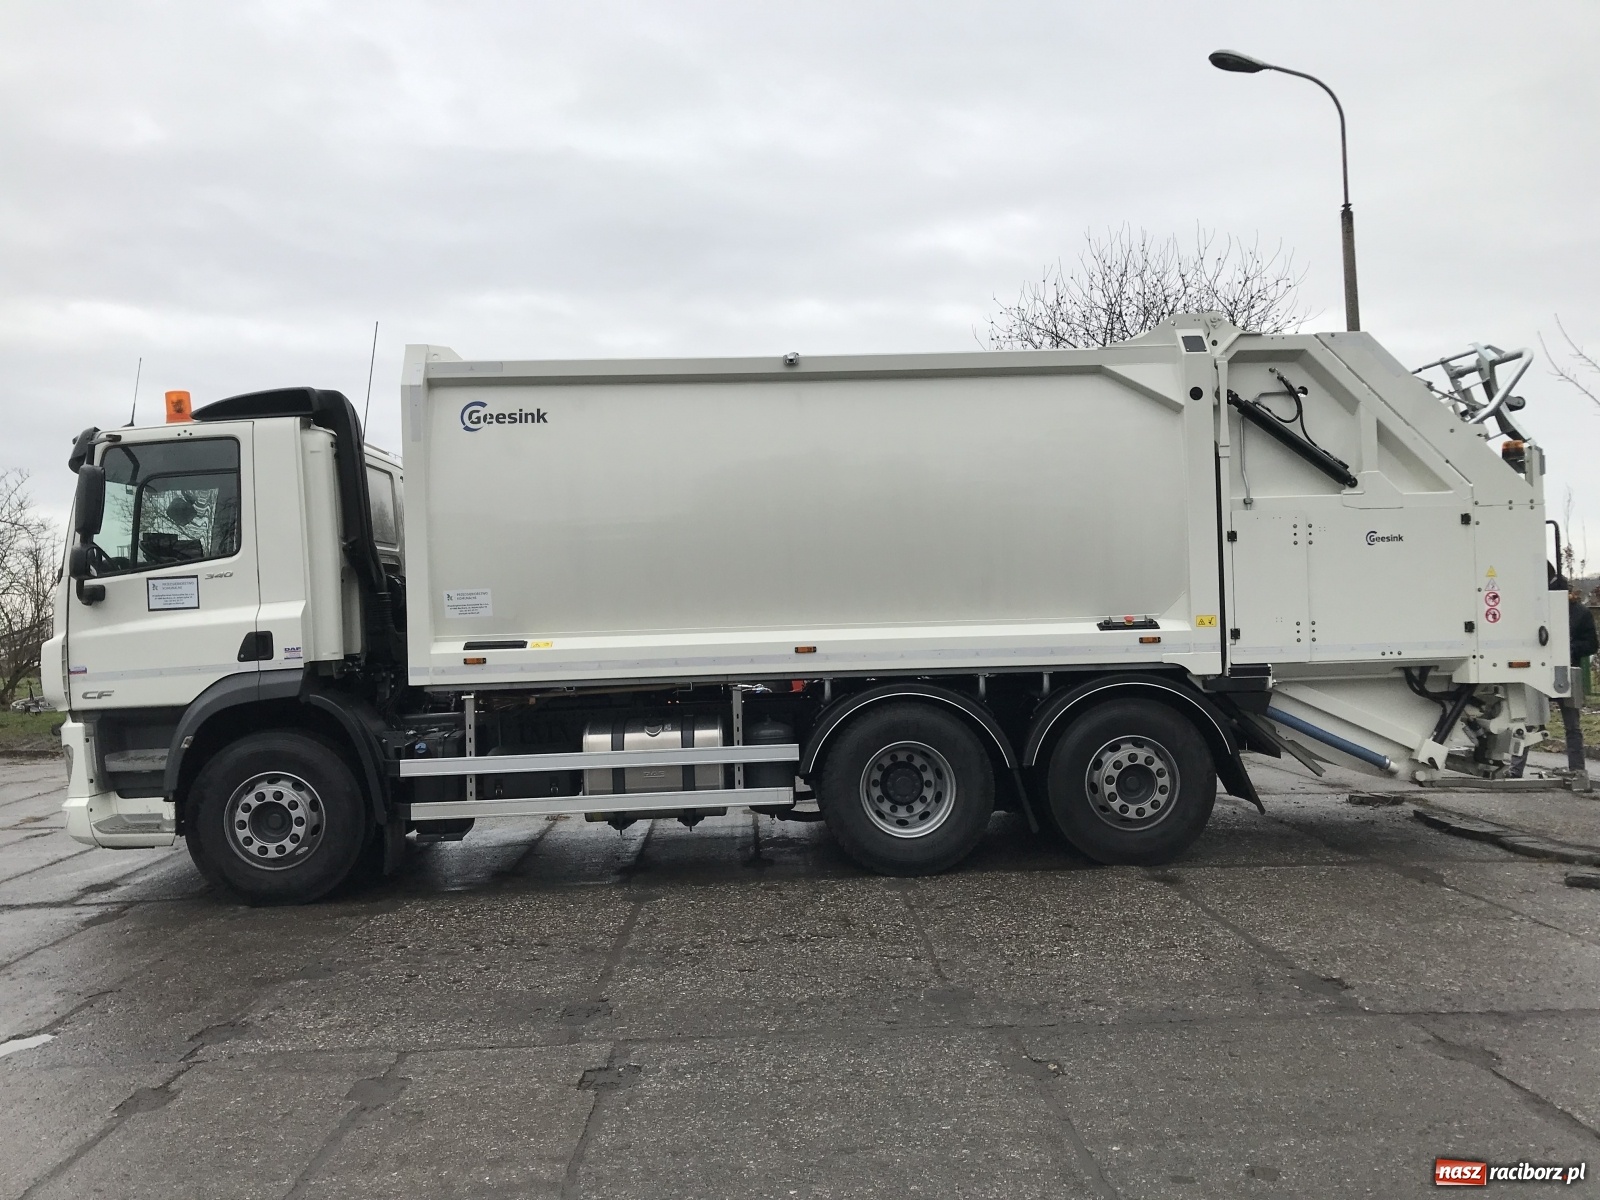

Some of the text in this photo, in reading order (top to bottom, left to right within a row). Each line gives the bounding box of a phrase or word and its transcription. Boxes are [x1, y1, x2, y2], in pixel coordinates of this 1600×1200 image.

[466, 407, 548, 425] Geesink
[1368, 533, 1404, 543] Geesink
[204, 571, 234, 580] 340
[81, 689, 115, 700] CF
